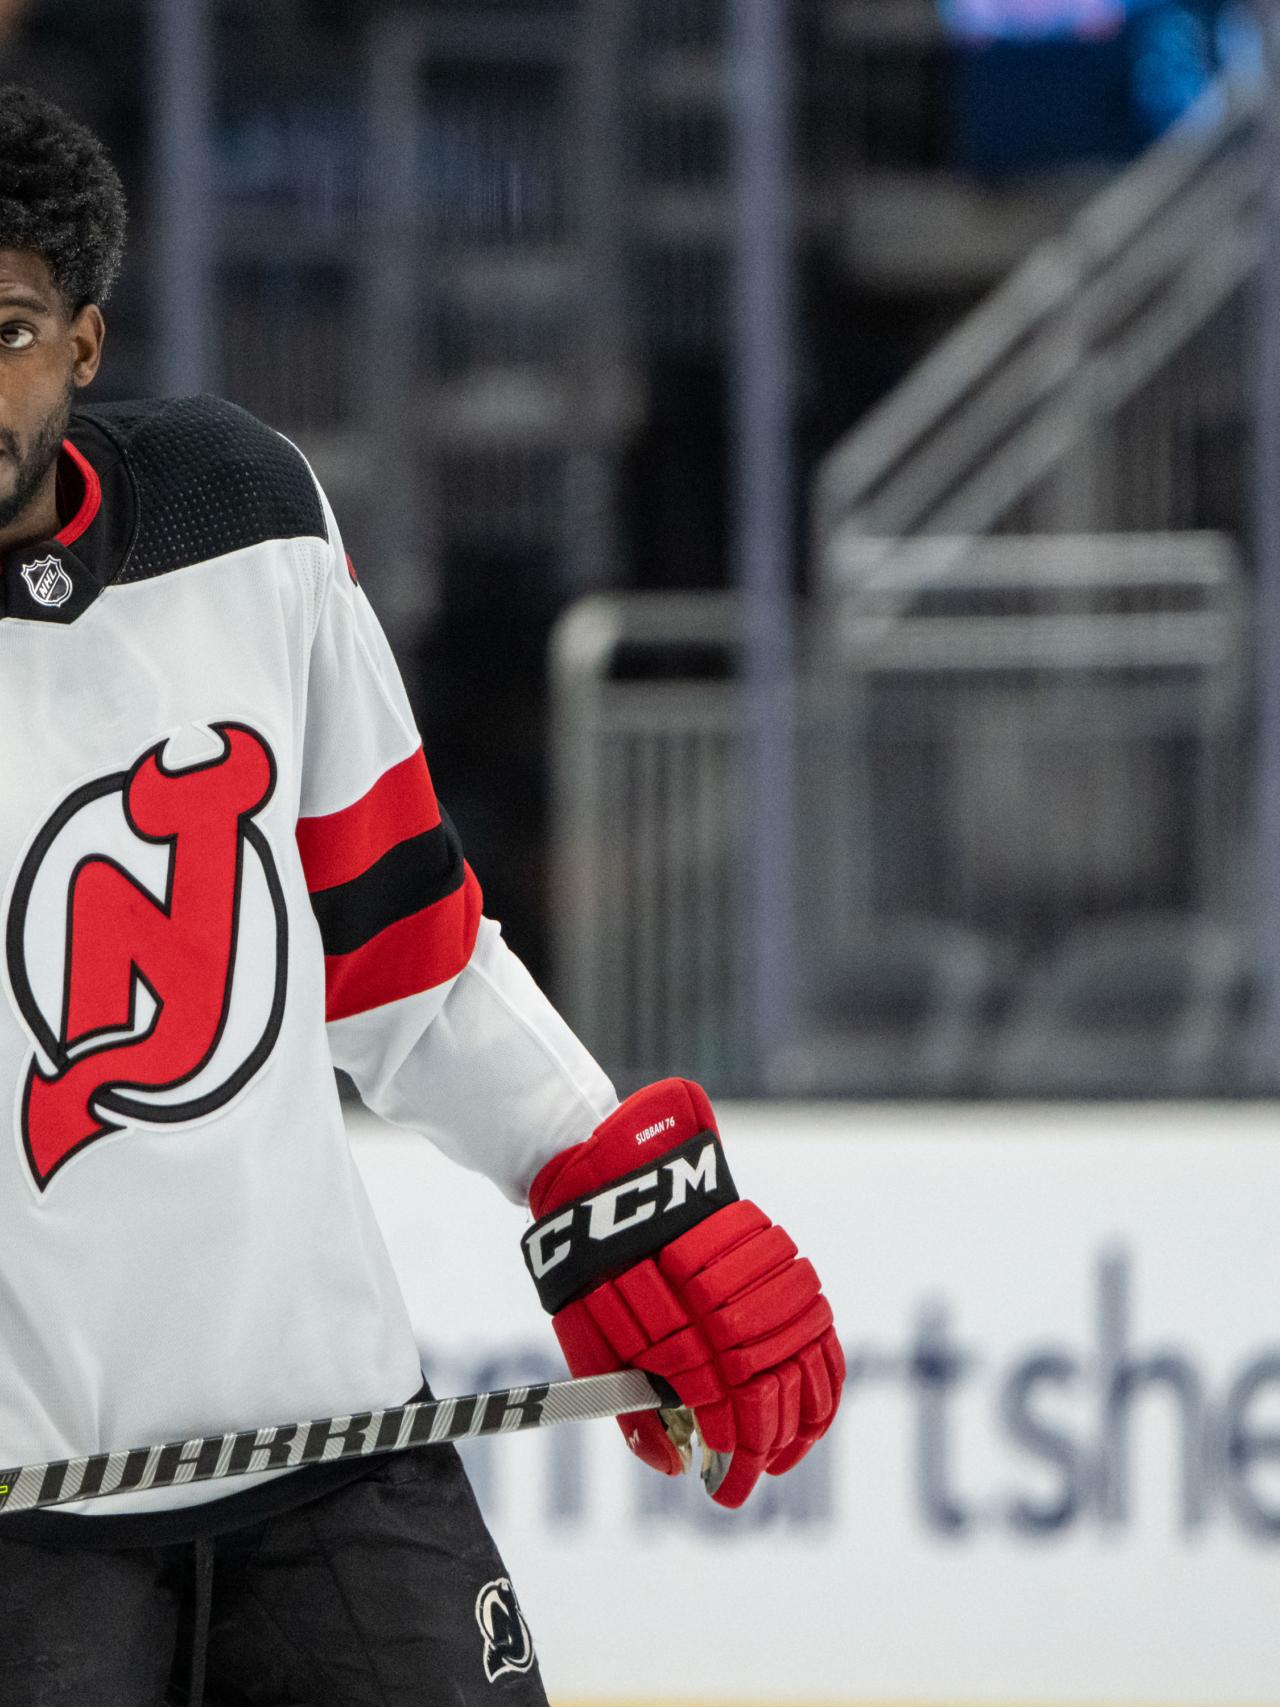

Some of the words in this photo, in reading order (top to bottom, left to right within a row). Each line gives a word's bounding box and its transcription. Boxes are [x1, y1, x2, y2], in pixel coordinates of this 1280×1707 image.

[38, 568, 58, 599] NHL
[635, 1120, 665, 1146] SUBBAN
[664, 1115, 676, 1129] 76
[525, 1142, 718, 1280] CCM
[34, 1383, 551, 1508] WARRIOR
